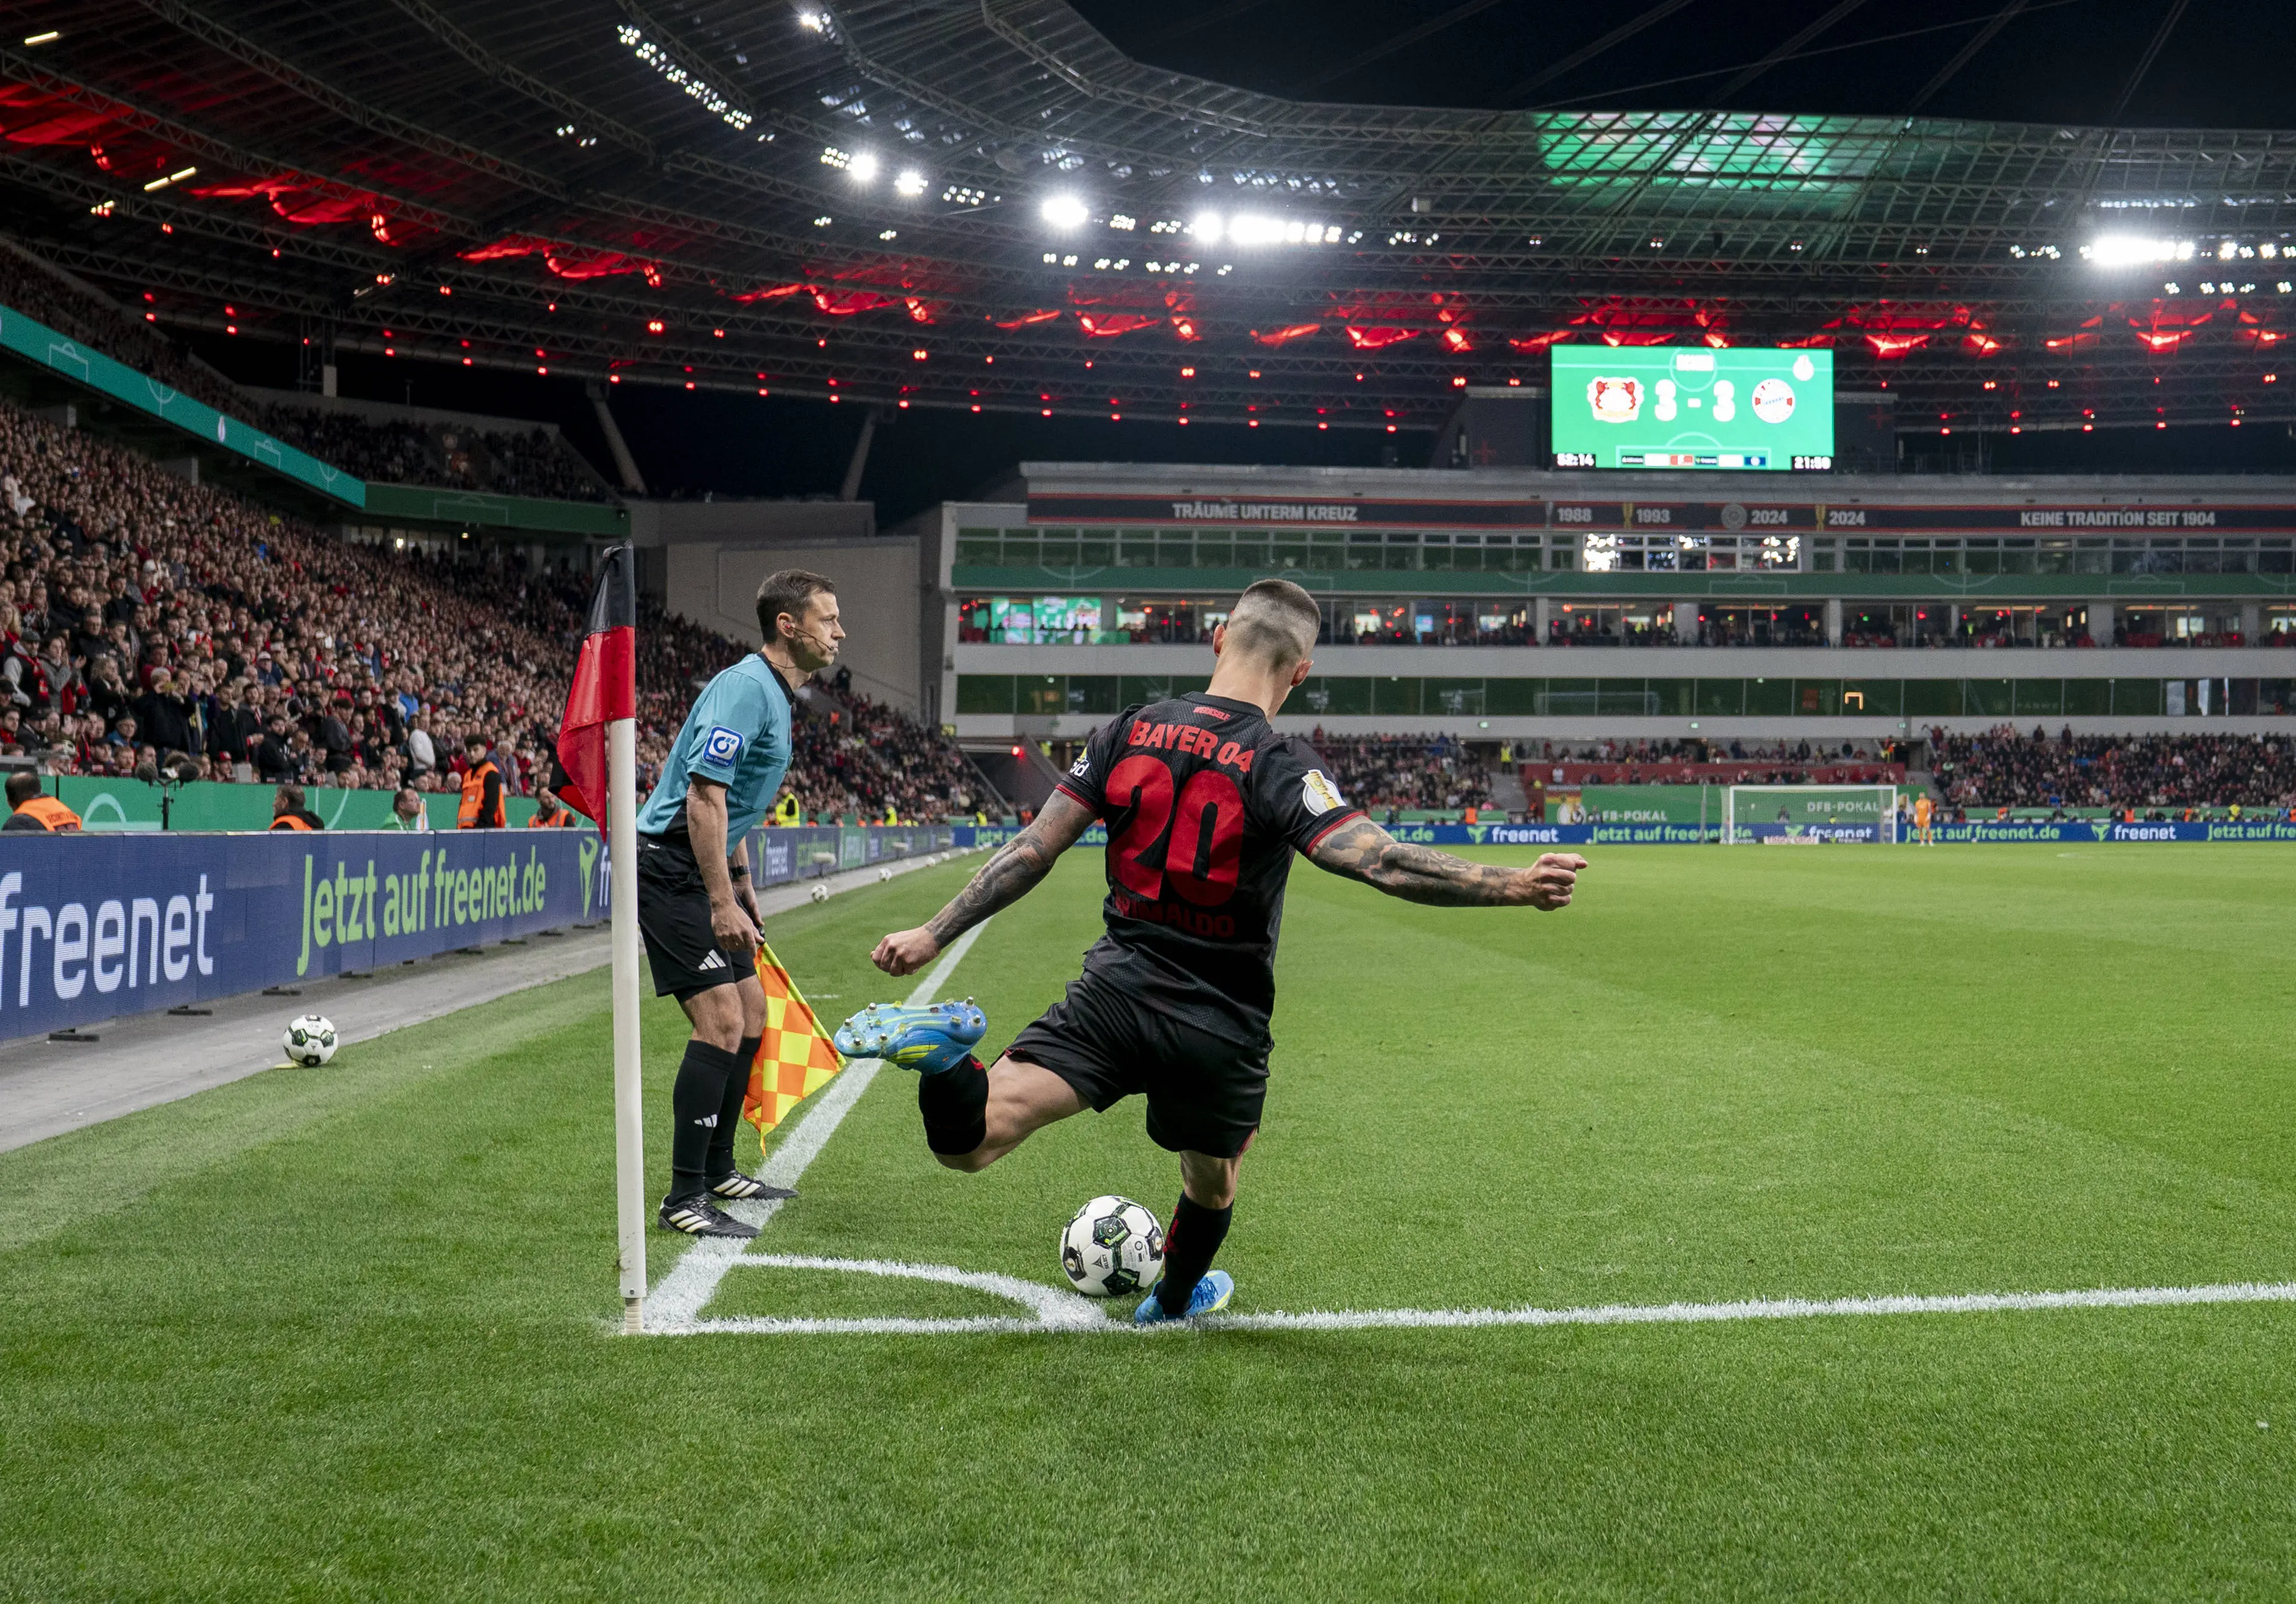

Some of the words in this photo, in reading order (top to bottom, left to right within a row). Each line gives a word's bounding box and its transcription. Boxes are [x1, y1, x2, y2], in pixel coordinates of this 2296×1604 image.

[1172, 501, 1238, 519] TRÄUME
[1239, 504, 1303, 520] UNTERM
[1306, 506, 1358, 521] KREUZ
[1636, 508, 1671, 523] 1993
[1751, 509, 1788, 524] 2024
[1829, 510, 1866, 525] 2024
[2020, 511, 2064, 526] KEINE
[2066, 510, 2145, 526] TRADITION
[2146, 512, 2180, 526] SEIT
[2181, 512, 2215, 526] 1904
[1128, 720, 1219, 760] BAYER
[1217, 741, 1256, 773] 04
[1601, 810, 1668, 822] FB-POKAL
[1106, 754, 1244, 907] 20
[1492, 826, 1560, 843] freenet
[1634, 825, 1661, 841] auf
[1665, 825, 1753, 841] freeetde
[1946, 825, 1972, 840] auf
[1976, 825, 2060, 840] freenet.de
[2114, 824, 2177, 840] freenet
[2246, 823, 2271, 838] auf
[297, 854, 377, 976] Jetzt
[383, 849, 430, 937] auf
[434, 845, 546, 929] freenet.de
[0, 871, 213, 1009] freenet
